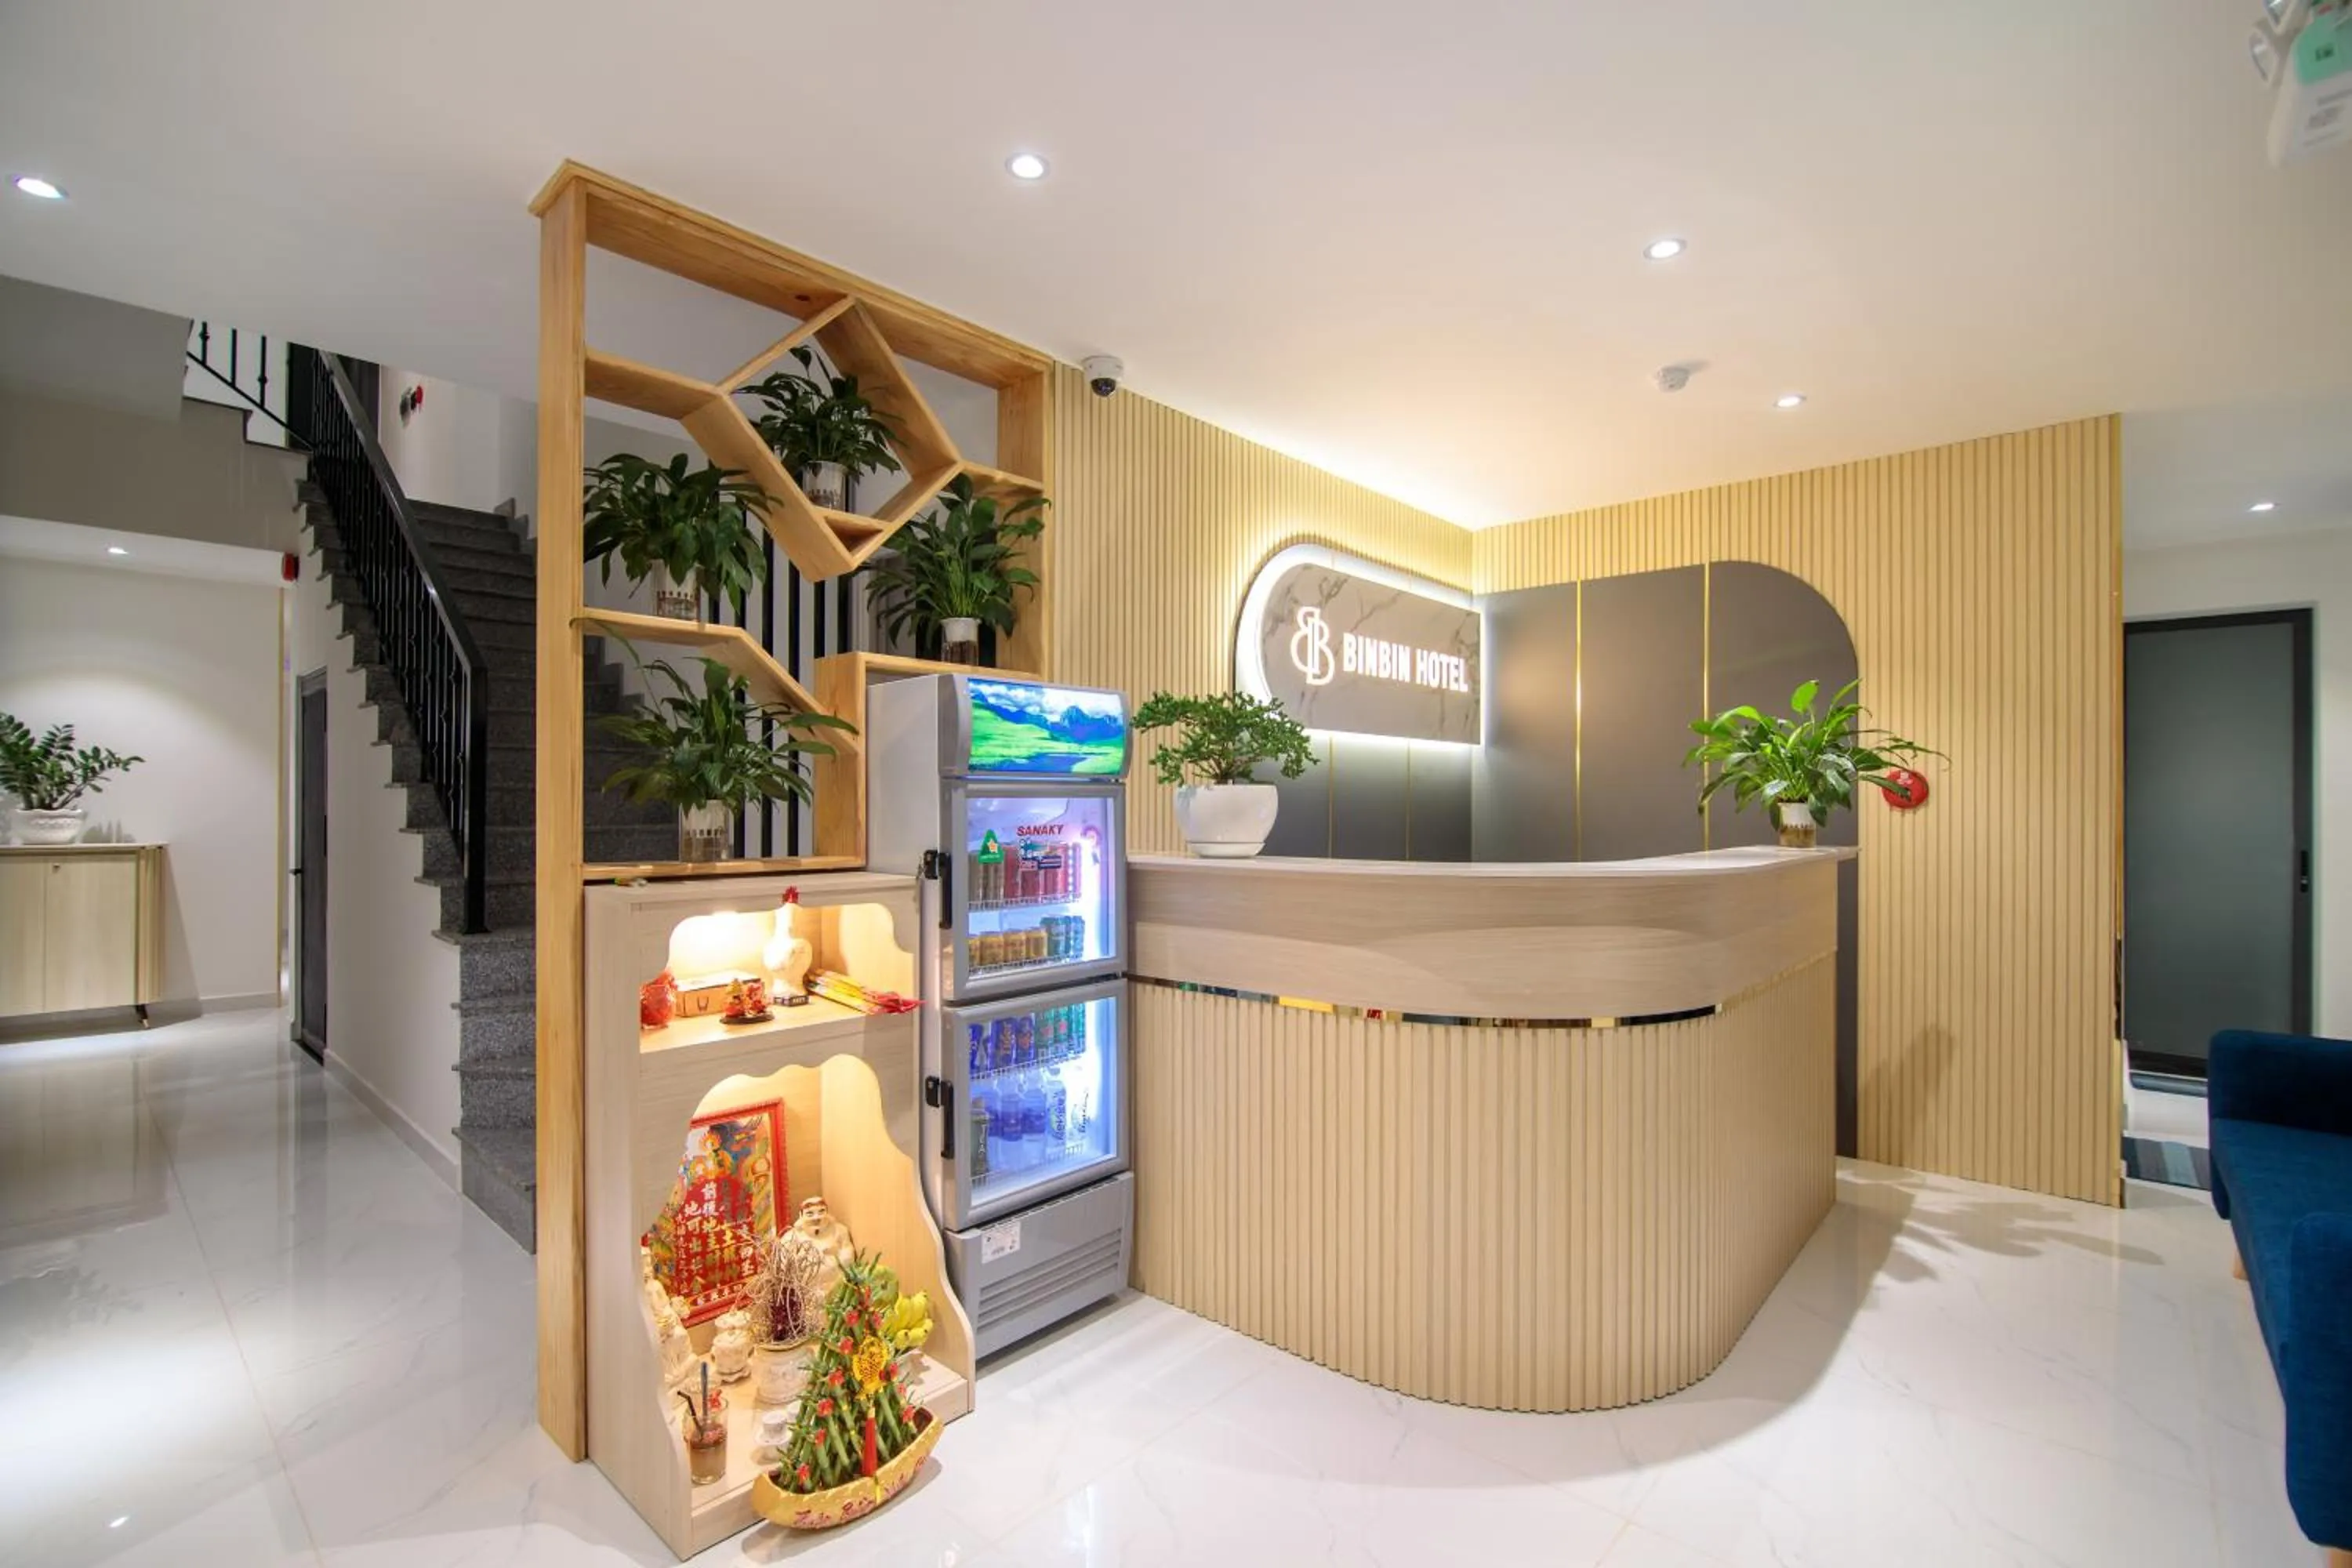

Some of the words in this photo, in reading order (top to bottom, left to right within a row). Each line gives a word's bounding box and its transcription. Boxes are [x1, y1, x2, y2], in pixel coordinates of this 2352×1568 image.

[1343, 632, 1410, 684] BINBIN
[1416, 648, 1468, 692] HOTEL
[1016, 824, 1065, 837] SANAKY
